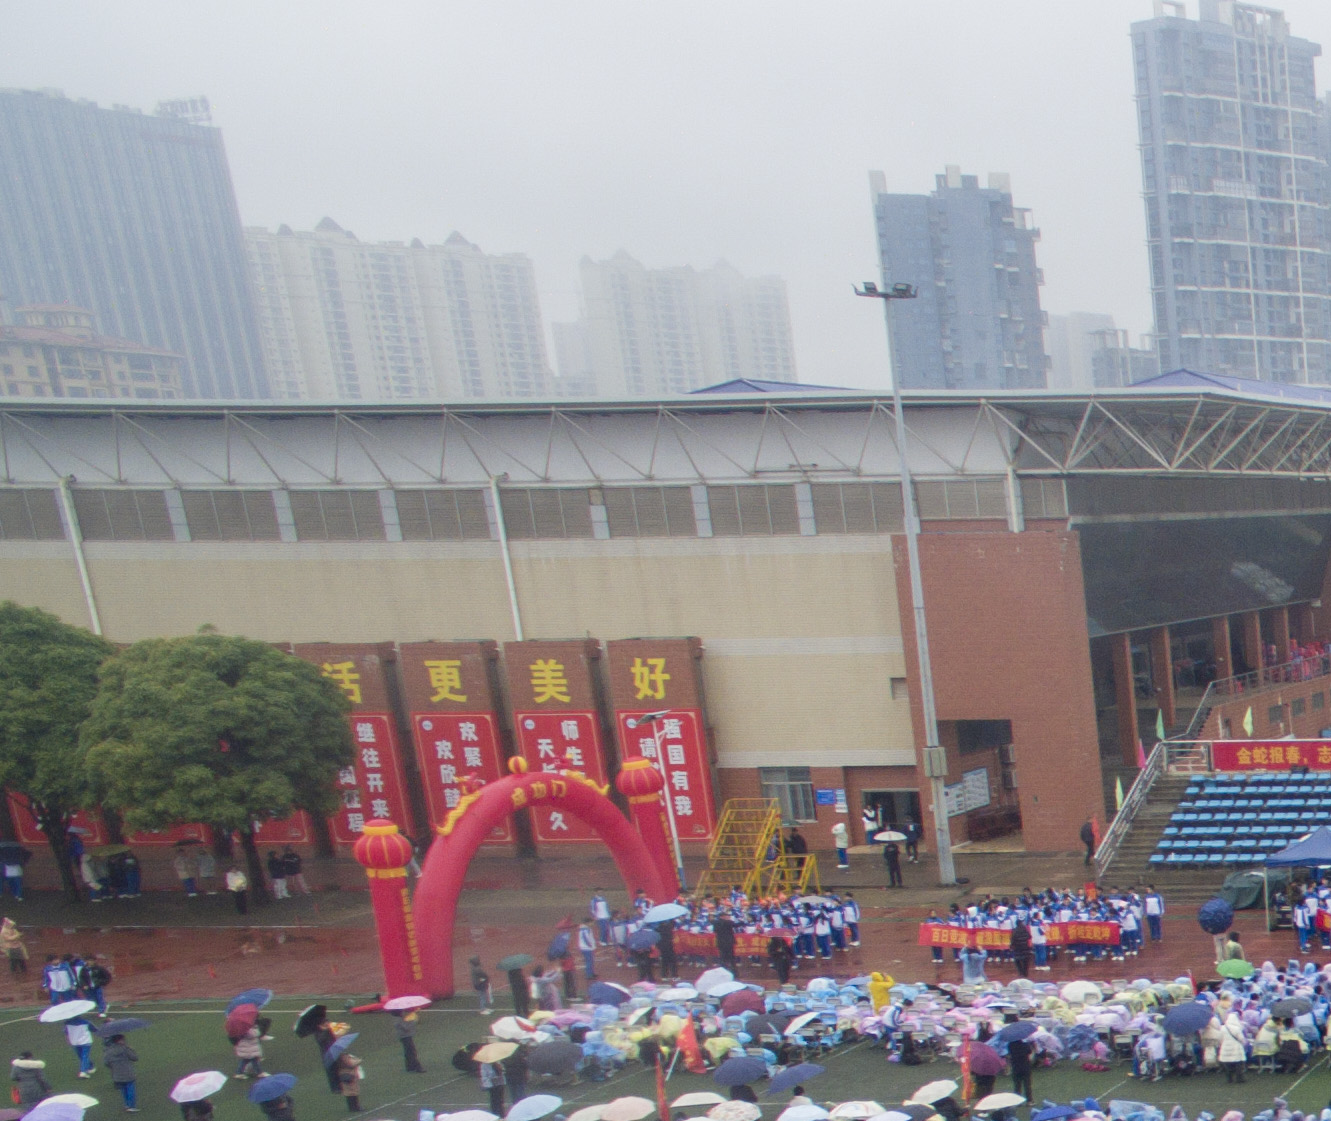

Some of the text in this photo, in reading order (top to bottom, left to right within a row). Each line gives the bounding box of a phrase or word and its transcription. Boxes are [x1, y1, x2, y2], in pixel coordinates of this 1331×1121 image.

[356, 722, 390, 818] 继往开来
[435, 739, 463, 808] 欢欣鼓
[663, 719, 693, 816] 强国有我
